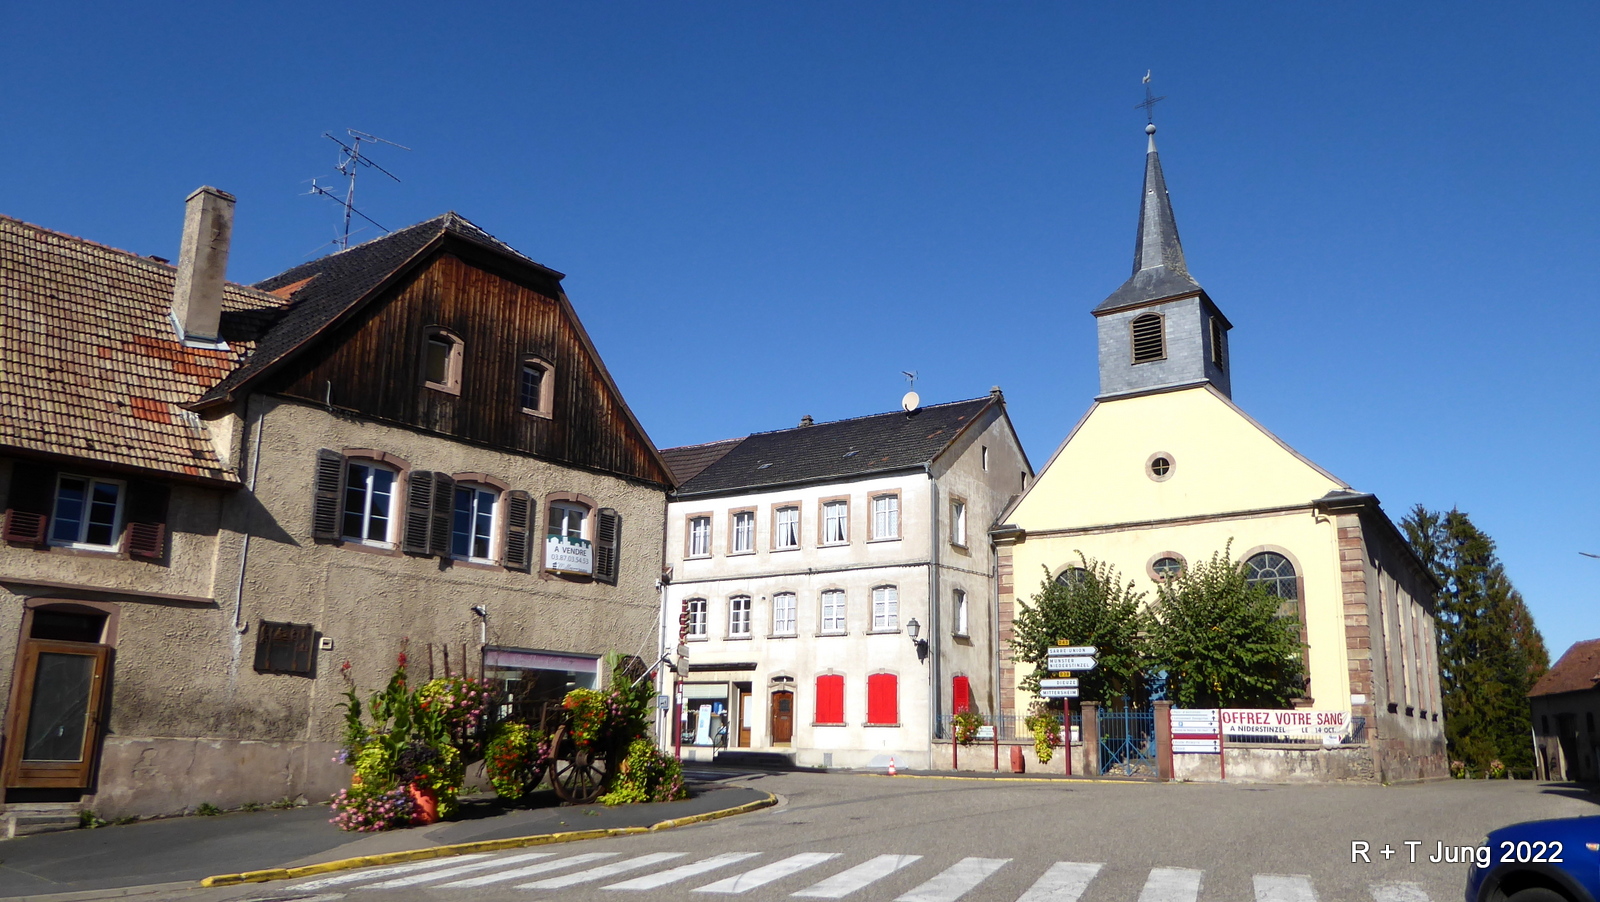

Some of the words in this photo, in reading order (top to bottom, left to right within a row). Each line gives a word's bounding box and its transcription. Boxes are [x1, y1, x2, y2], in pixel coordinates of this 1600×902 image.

[562, 547, 587, 556] VENDRE
[1222, 711, 1270, 725] OFFREZ
[1275, 712, 1312, 725] VOTRE
[1317, 712, 1343, 725] SANG
